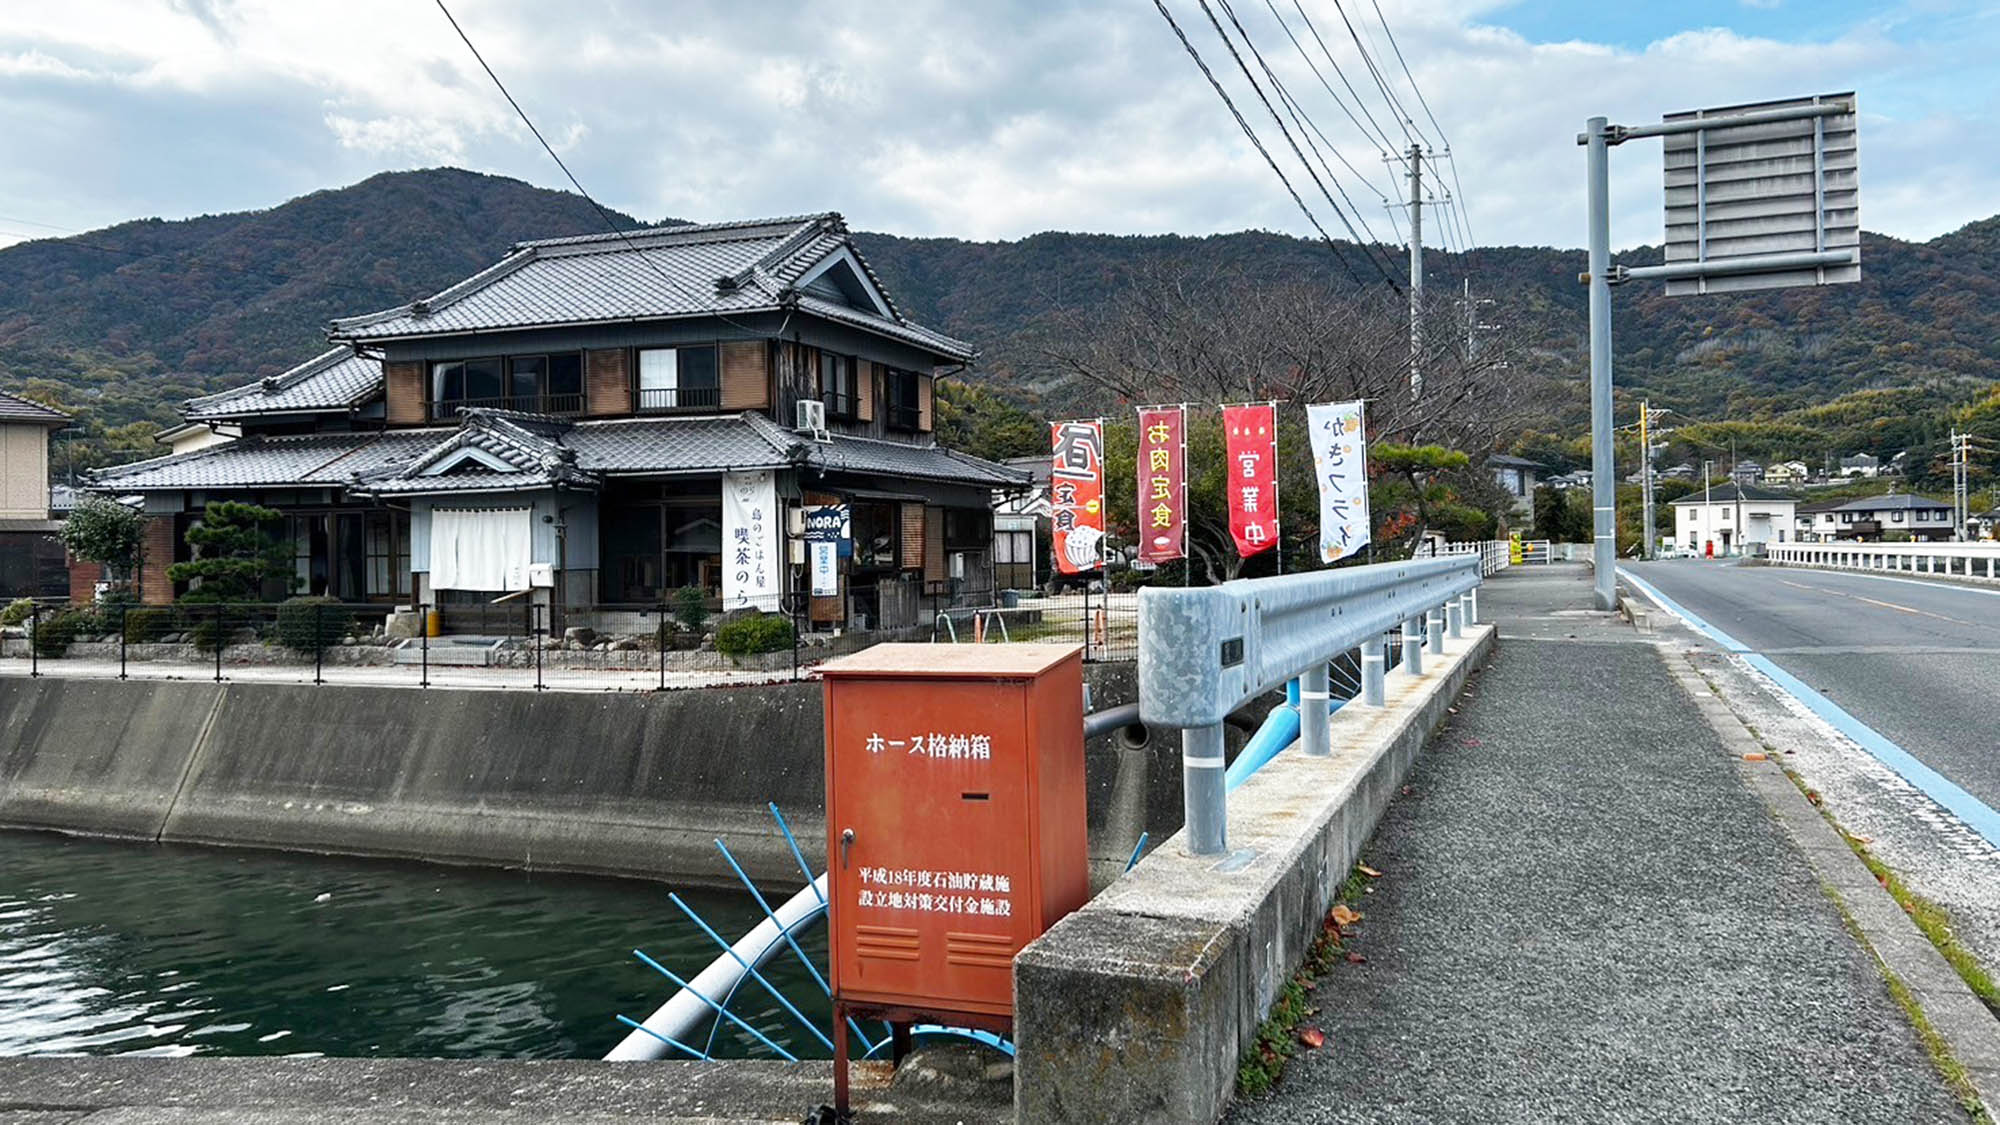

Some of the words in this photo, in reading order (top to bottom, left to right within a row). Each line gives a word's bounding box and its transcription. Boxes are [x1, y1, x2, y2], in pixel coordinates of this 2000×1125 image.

[807, 515, 841, 529] NORA
[734, 528, 751, 606] 喫茶のら
[865, 732, 991, 760] ホース格納箱
[858, 866, 1011, 893] 平成18年度石油貯蔵施
[858, 889, 1012, 917] 設立地対策交付金施設
